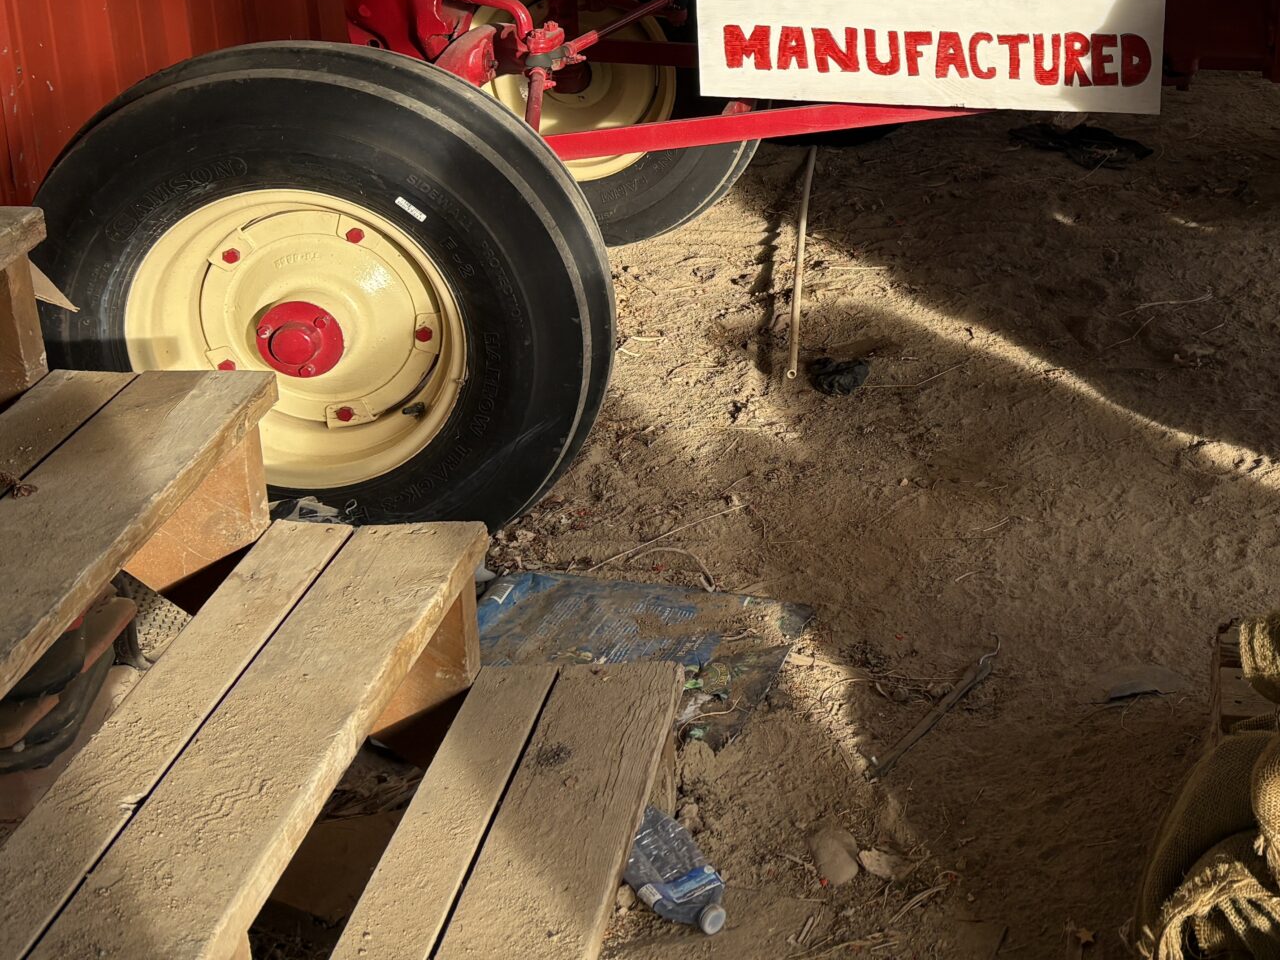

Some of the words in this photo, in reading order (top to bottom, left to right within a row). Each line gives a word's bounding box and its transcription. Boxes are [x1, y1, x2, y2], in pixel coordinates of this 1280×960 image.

[723, 24, 1153, 88] MANUFACTURED
[112, 159, 237, 236] SAMSON
[405, 174, 473, 233] SIDEWALL
